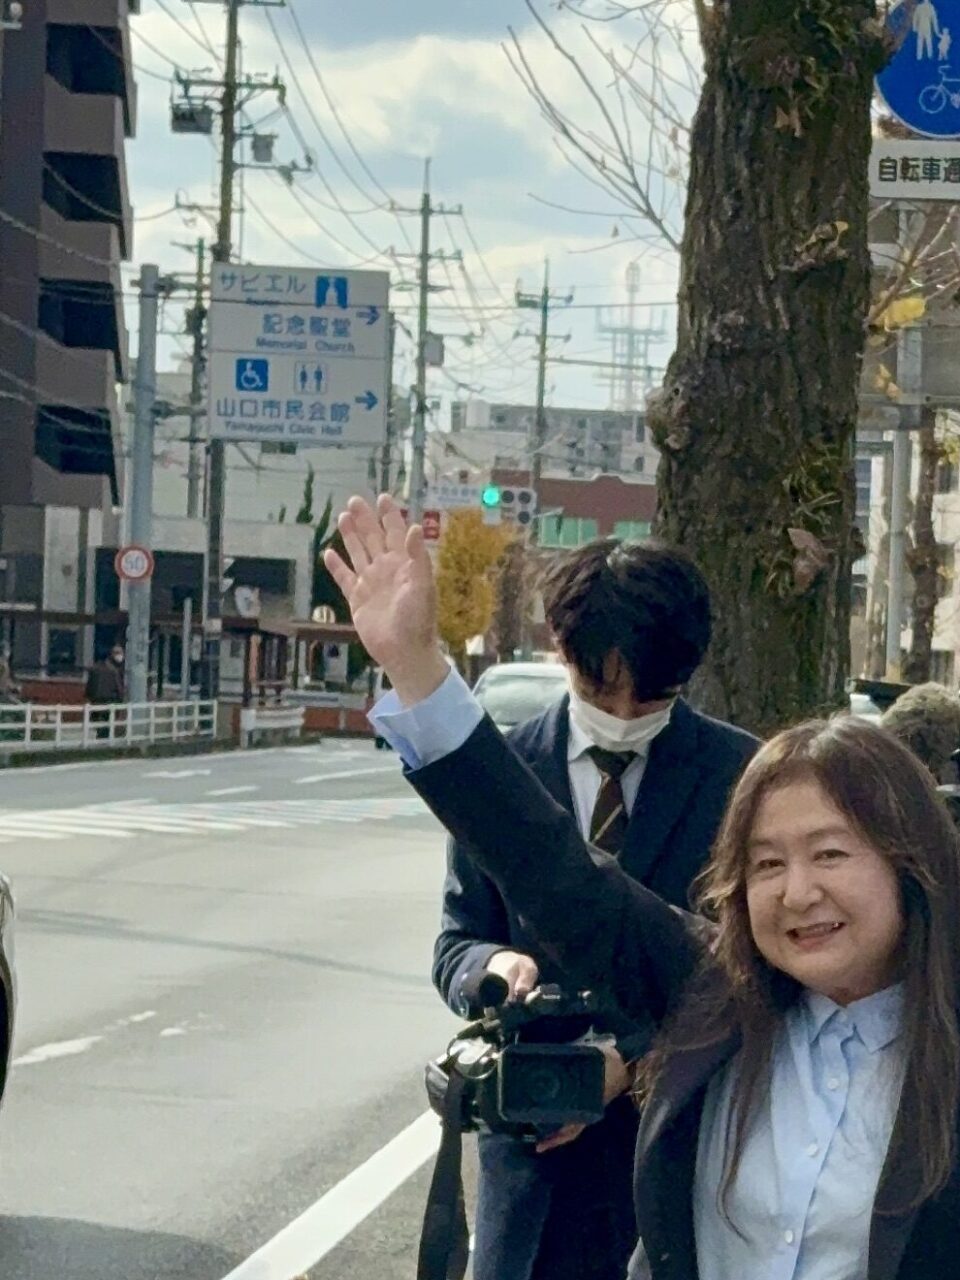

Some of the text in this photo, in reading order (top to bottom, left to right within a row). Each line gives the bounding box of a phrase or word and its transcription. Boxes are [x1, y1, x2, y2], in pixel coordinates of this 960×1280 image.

[216, 398, 350, 423] 山口市民会館
